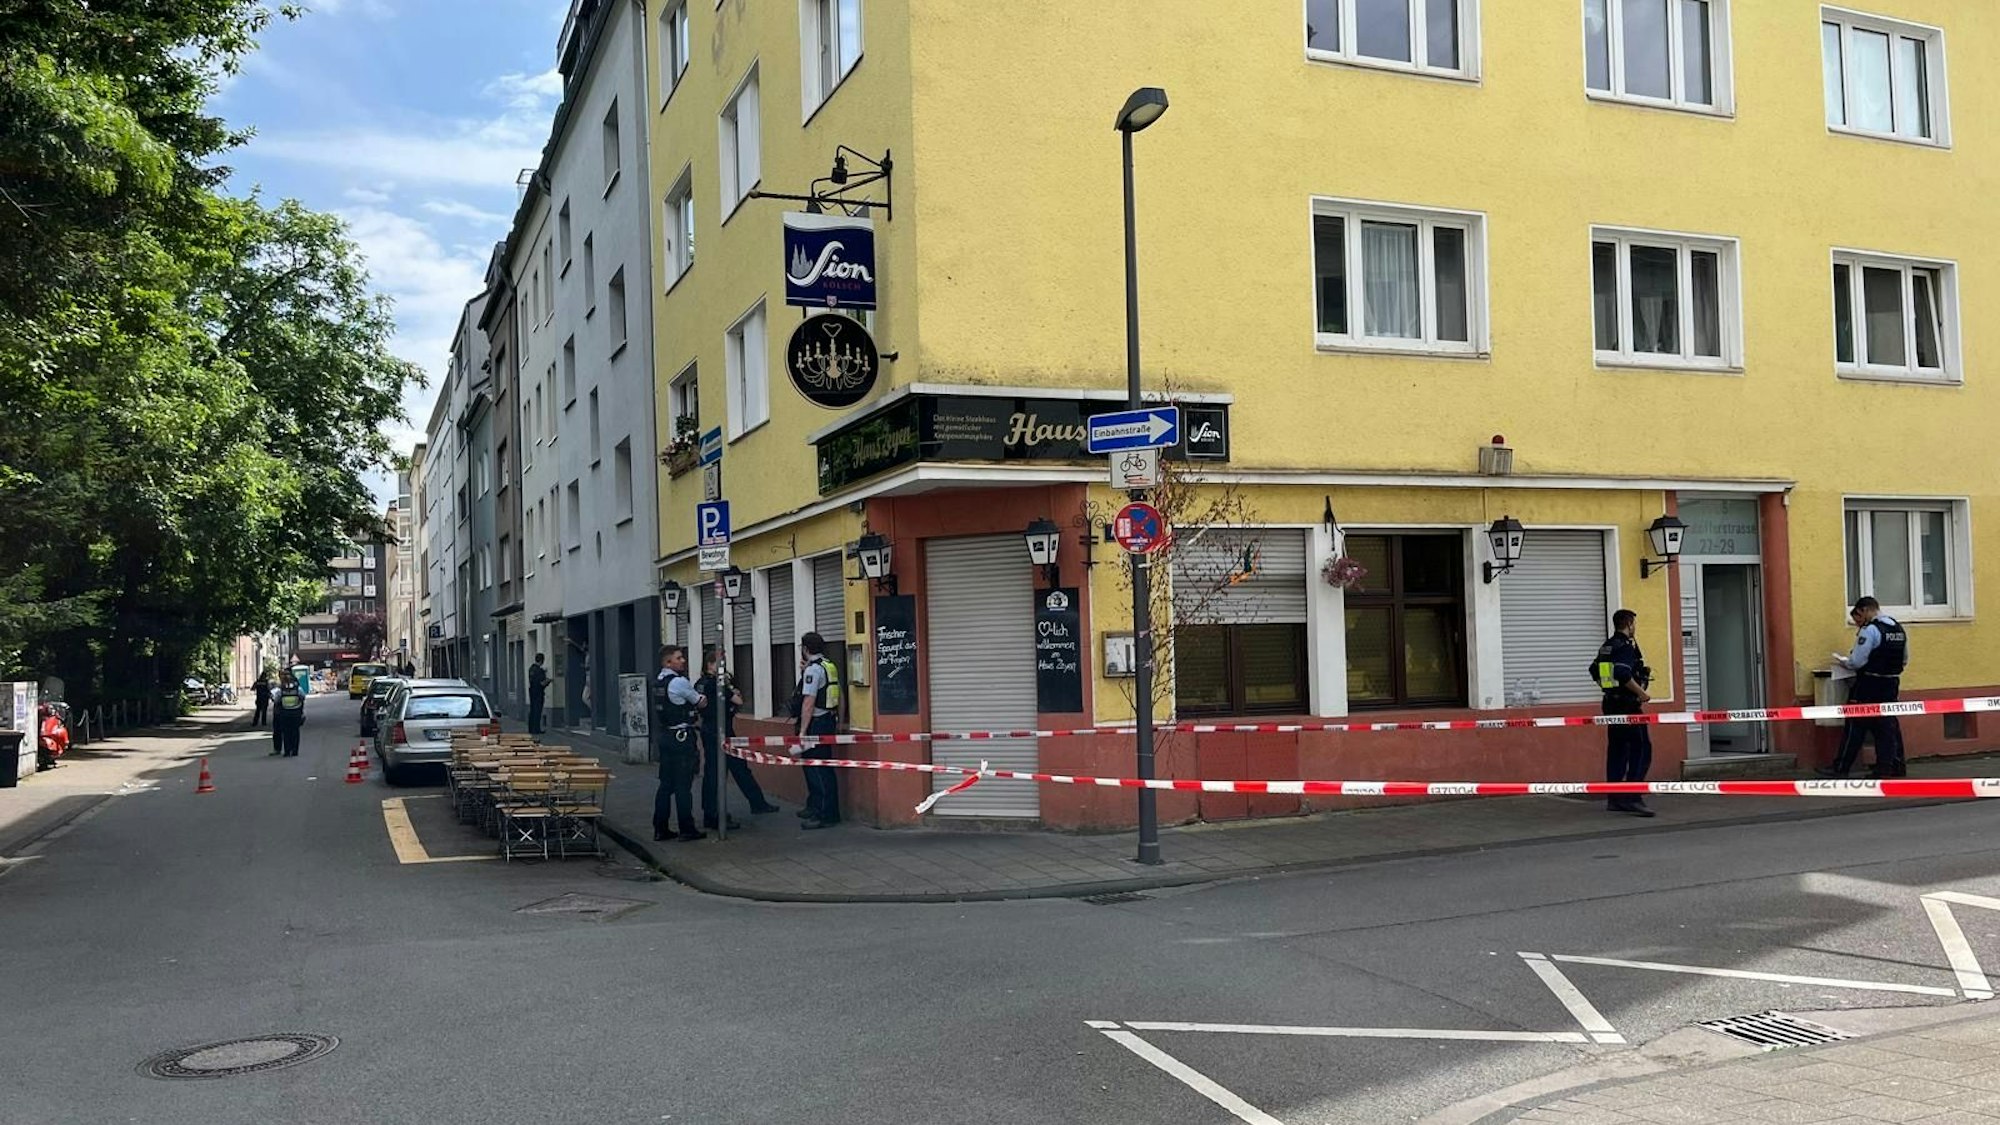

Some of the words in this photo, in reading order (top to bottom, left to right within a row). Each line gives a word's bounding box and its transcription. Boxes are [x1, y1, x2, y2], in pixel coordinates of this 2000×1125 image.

[787, 241, 873, 287] Sion
[1003, 412, 1087, 446] Haus
[1094, 425, 1151, 438] Einbahnstraße
[1189, 422, 1220, 442] Sion
[702, 507, 720, 538] P
[1699, 538, 1735, 554] 27-29
[877, 626, 907, 641] Frischer
